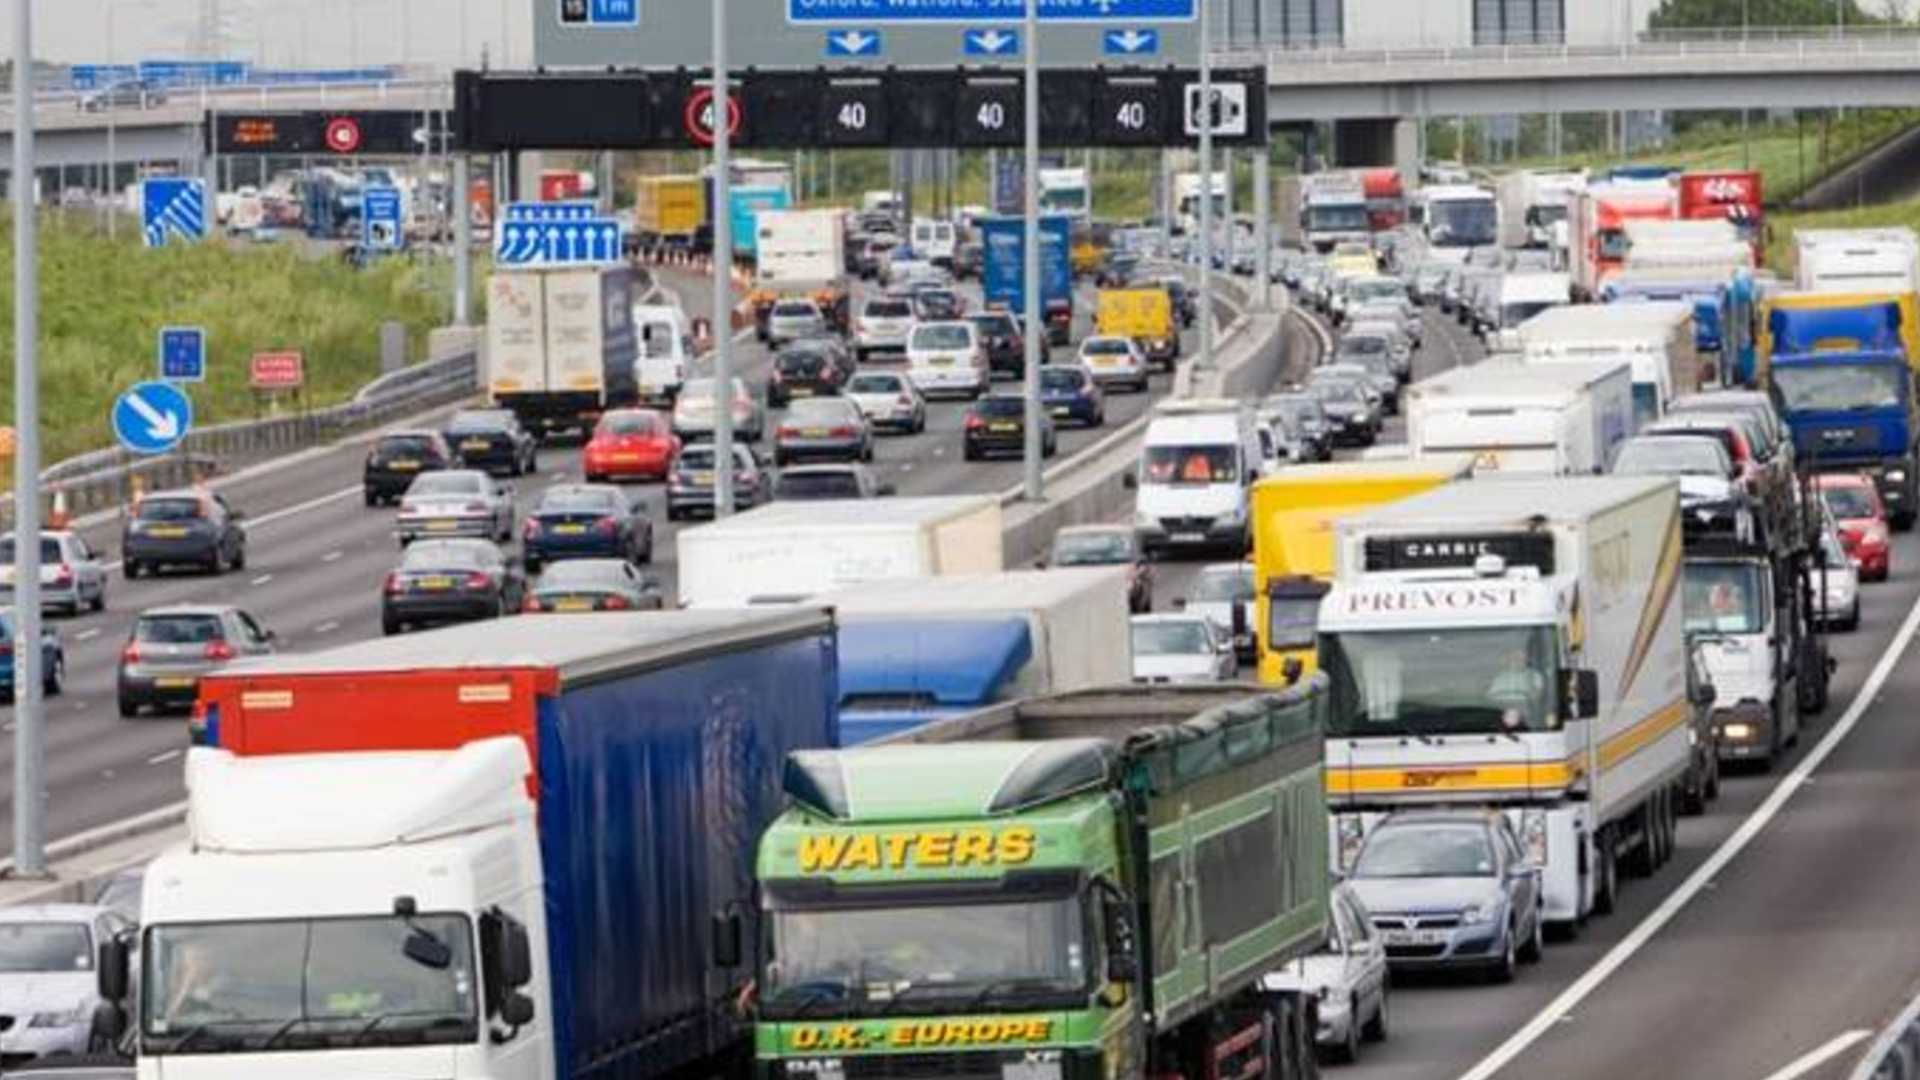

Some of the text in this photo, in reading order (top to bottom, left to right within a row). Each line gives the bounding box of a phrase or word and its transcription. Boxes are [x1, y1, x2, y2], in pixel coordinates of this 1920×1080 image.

[837, 101, 866, 129] 40
[976, 101, 1004, 129] 40
[1116, 101, 1144, 129] 40
[1348, 588, 1520, 613] PREVOST
[799, 825, 1034, 874] WATERS
[891, 1019, 1051, 1046] EUROPE
